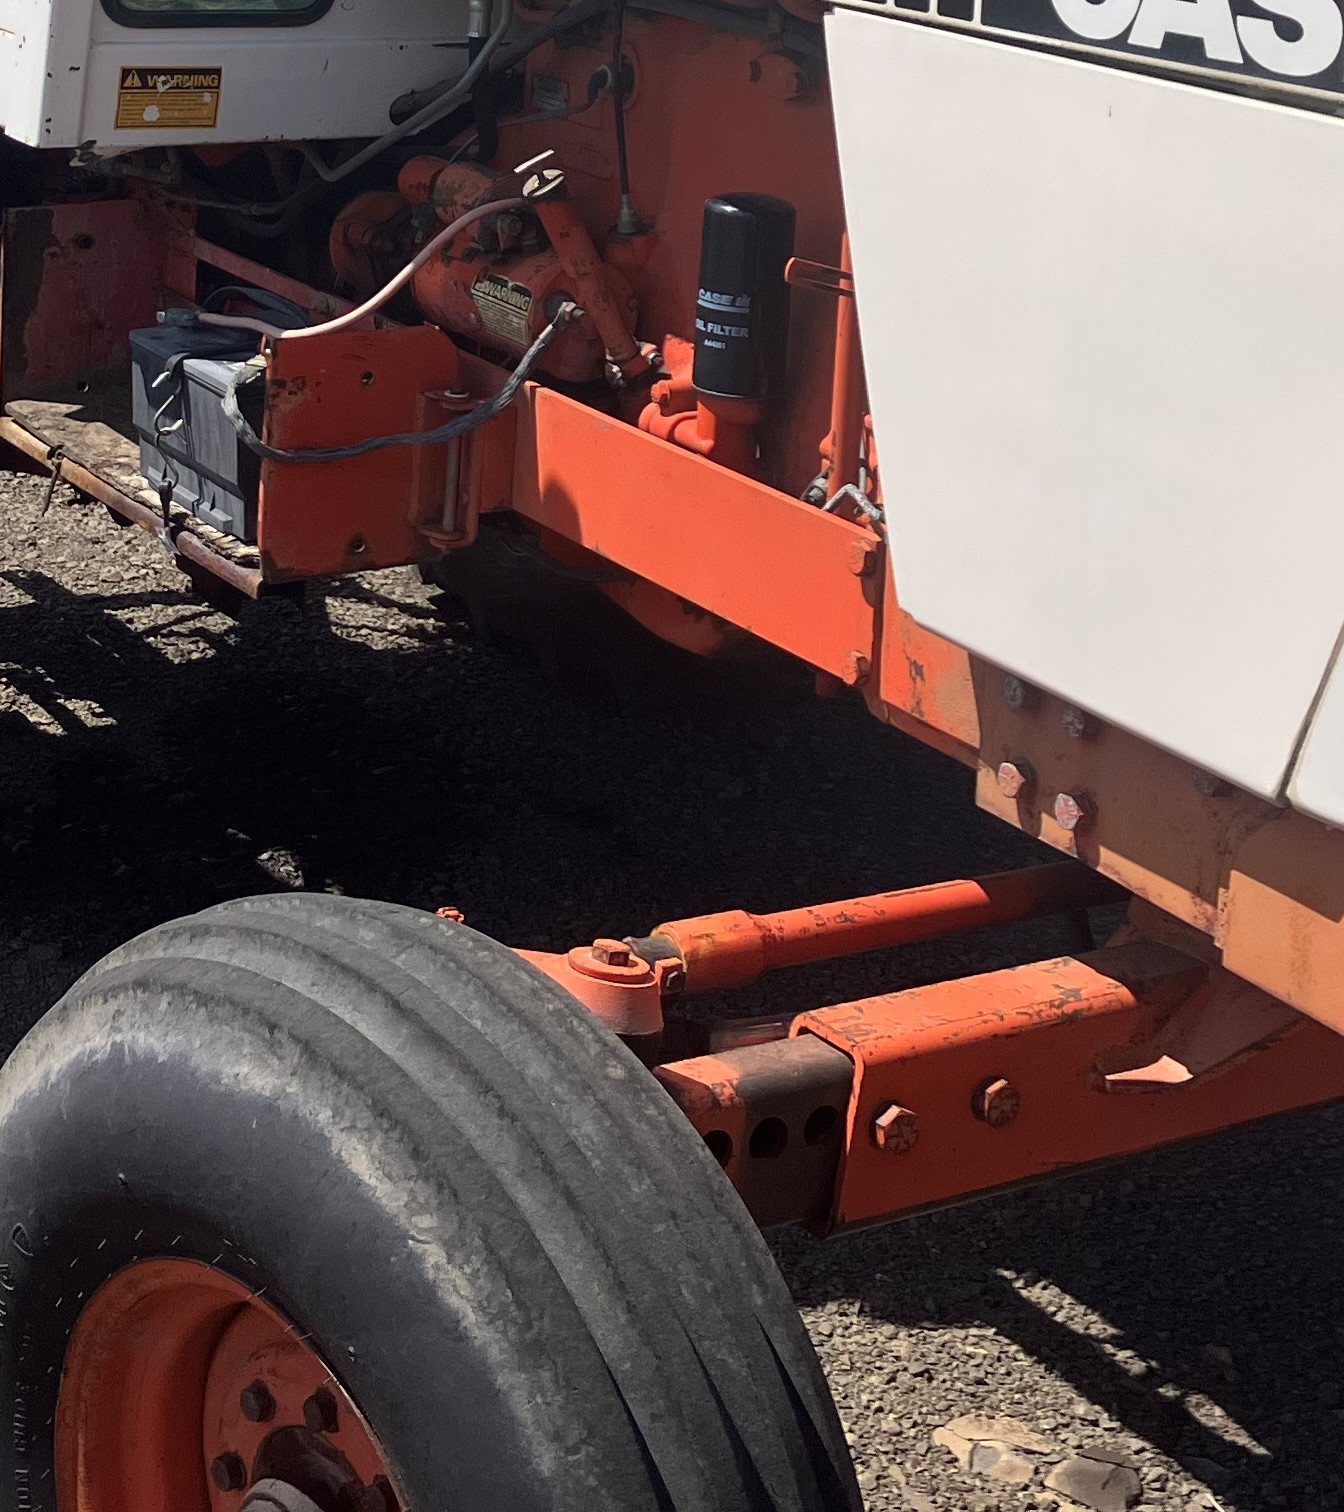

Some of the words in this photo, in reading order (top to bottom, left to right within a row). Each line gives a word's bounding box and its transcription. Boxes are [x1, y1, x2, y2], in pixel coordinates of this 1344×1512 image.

[488, 282, 531, 310] WARNING
[699, 288, 734, 306] CASE
[707, 322, 749, 337] FILTER
